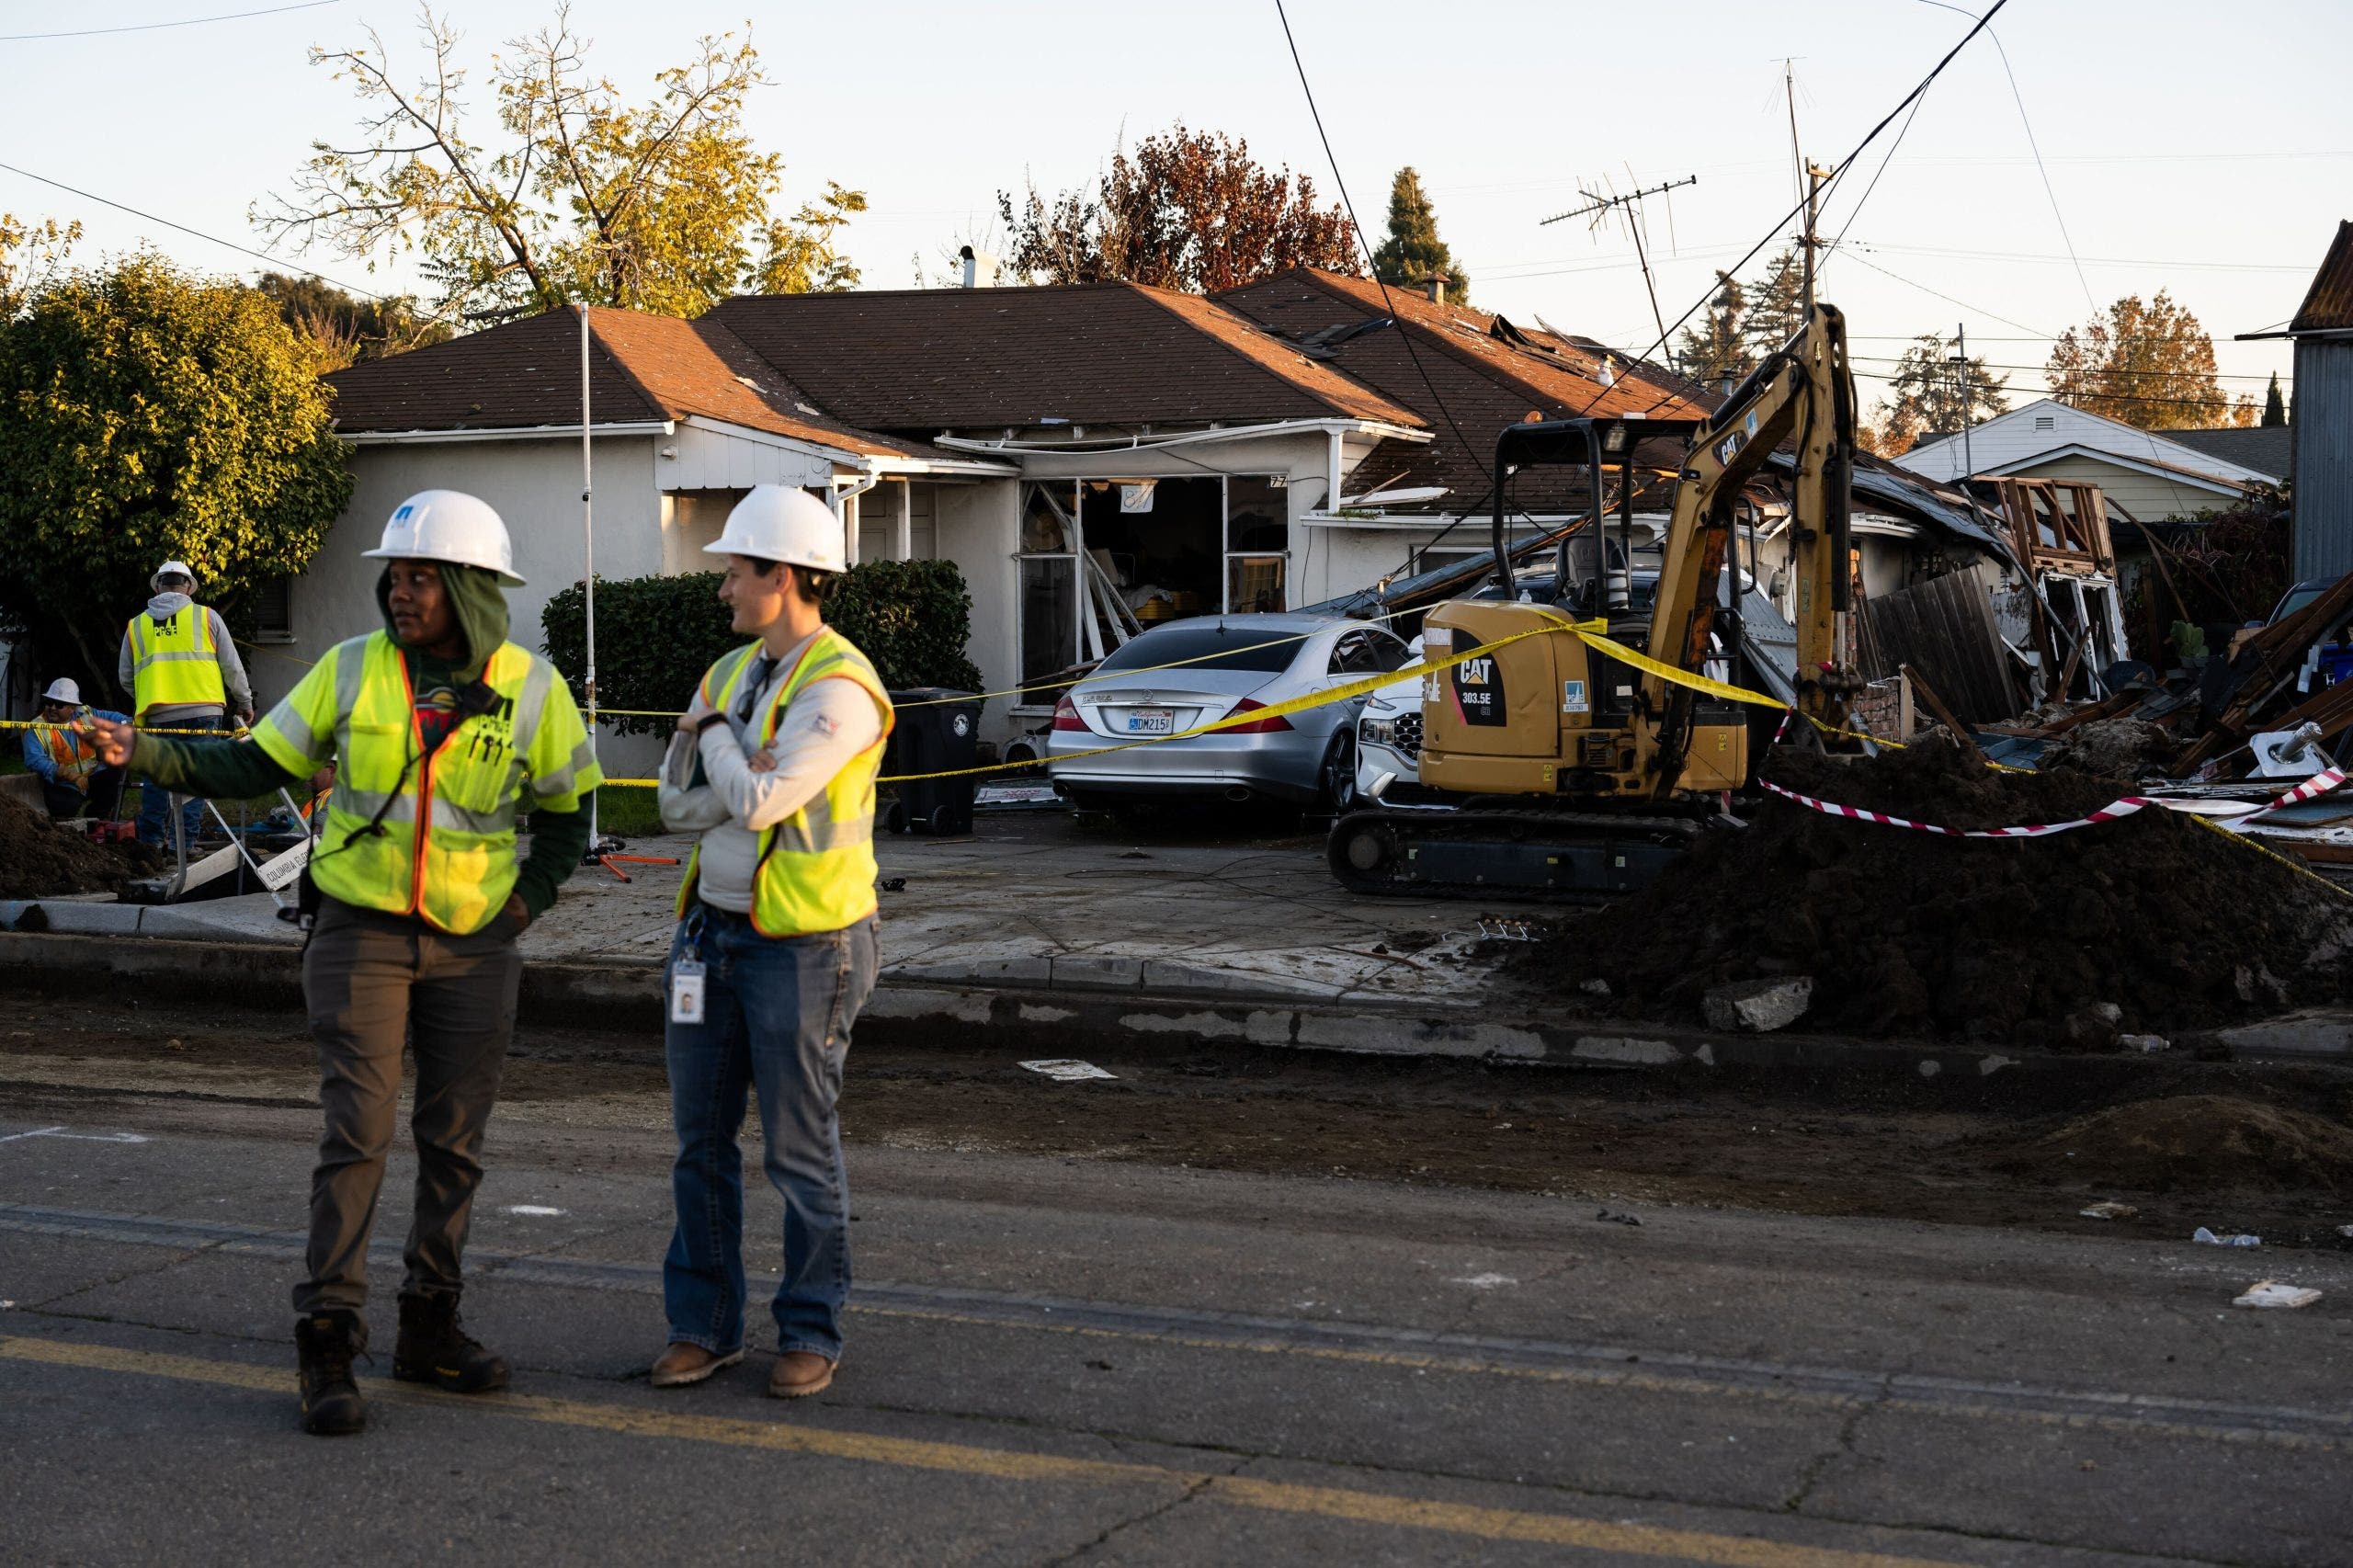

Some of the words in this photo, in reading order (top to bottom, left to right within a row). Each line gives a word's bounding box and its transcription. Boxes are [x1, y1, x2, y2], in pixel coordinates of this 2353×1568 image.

[1722, 434, 1737, 465] CAT
[1272, 476, 1286, 487] 77
[1460, 658, 1492, 685] CAT
[1462, 692, 1492, 705] 303.5E
[1138, 719, 1165, 731] DM215
[267, 860, 297, 882] COLUMBIA
